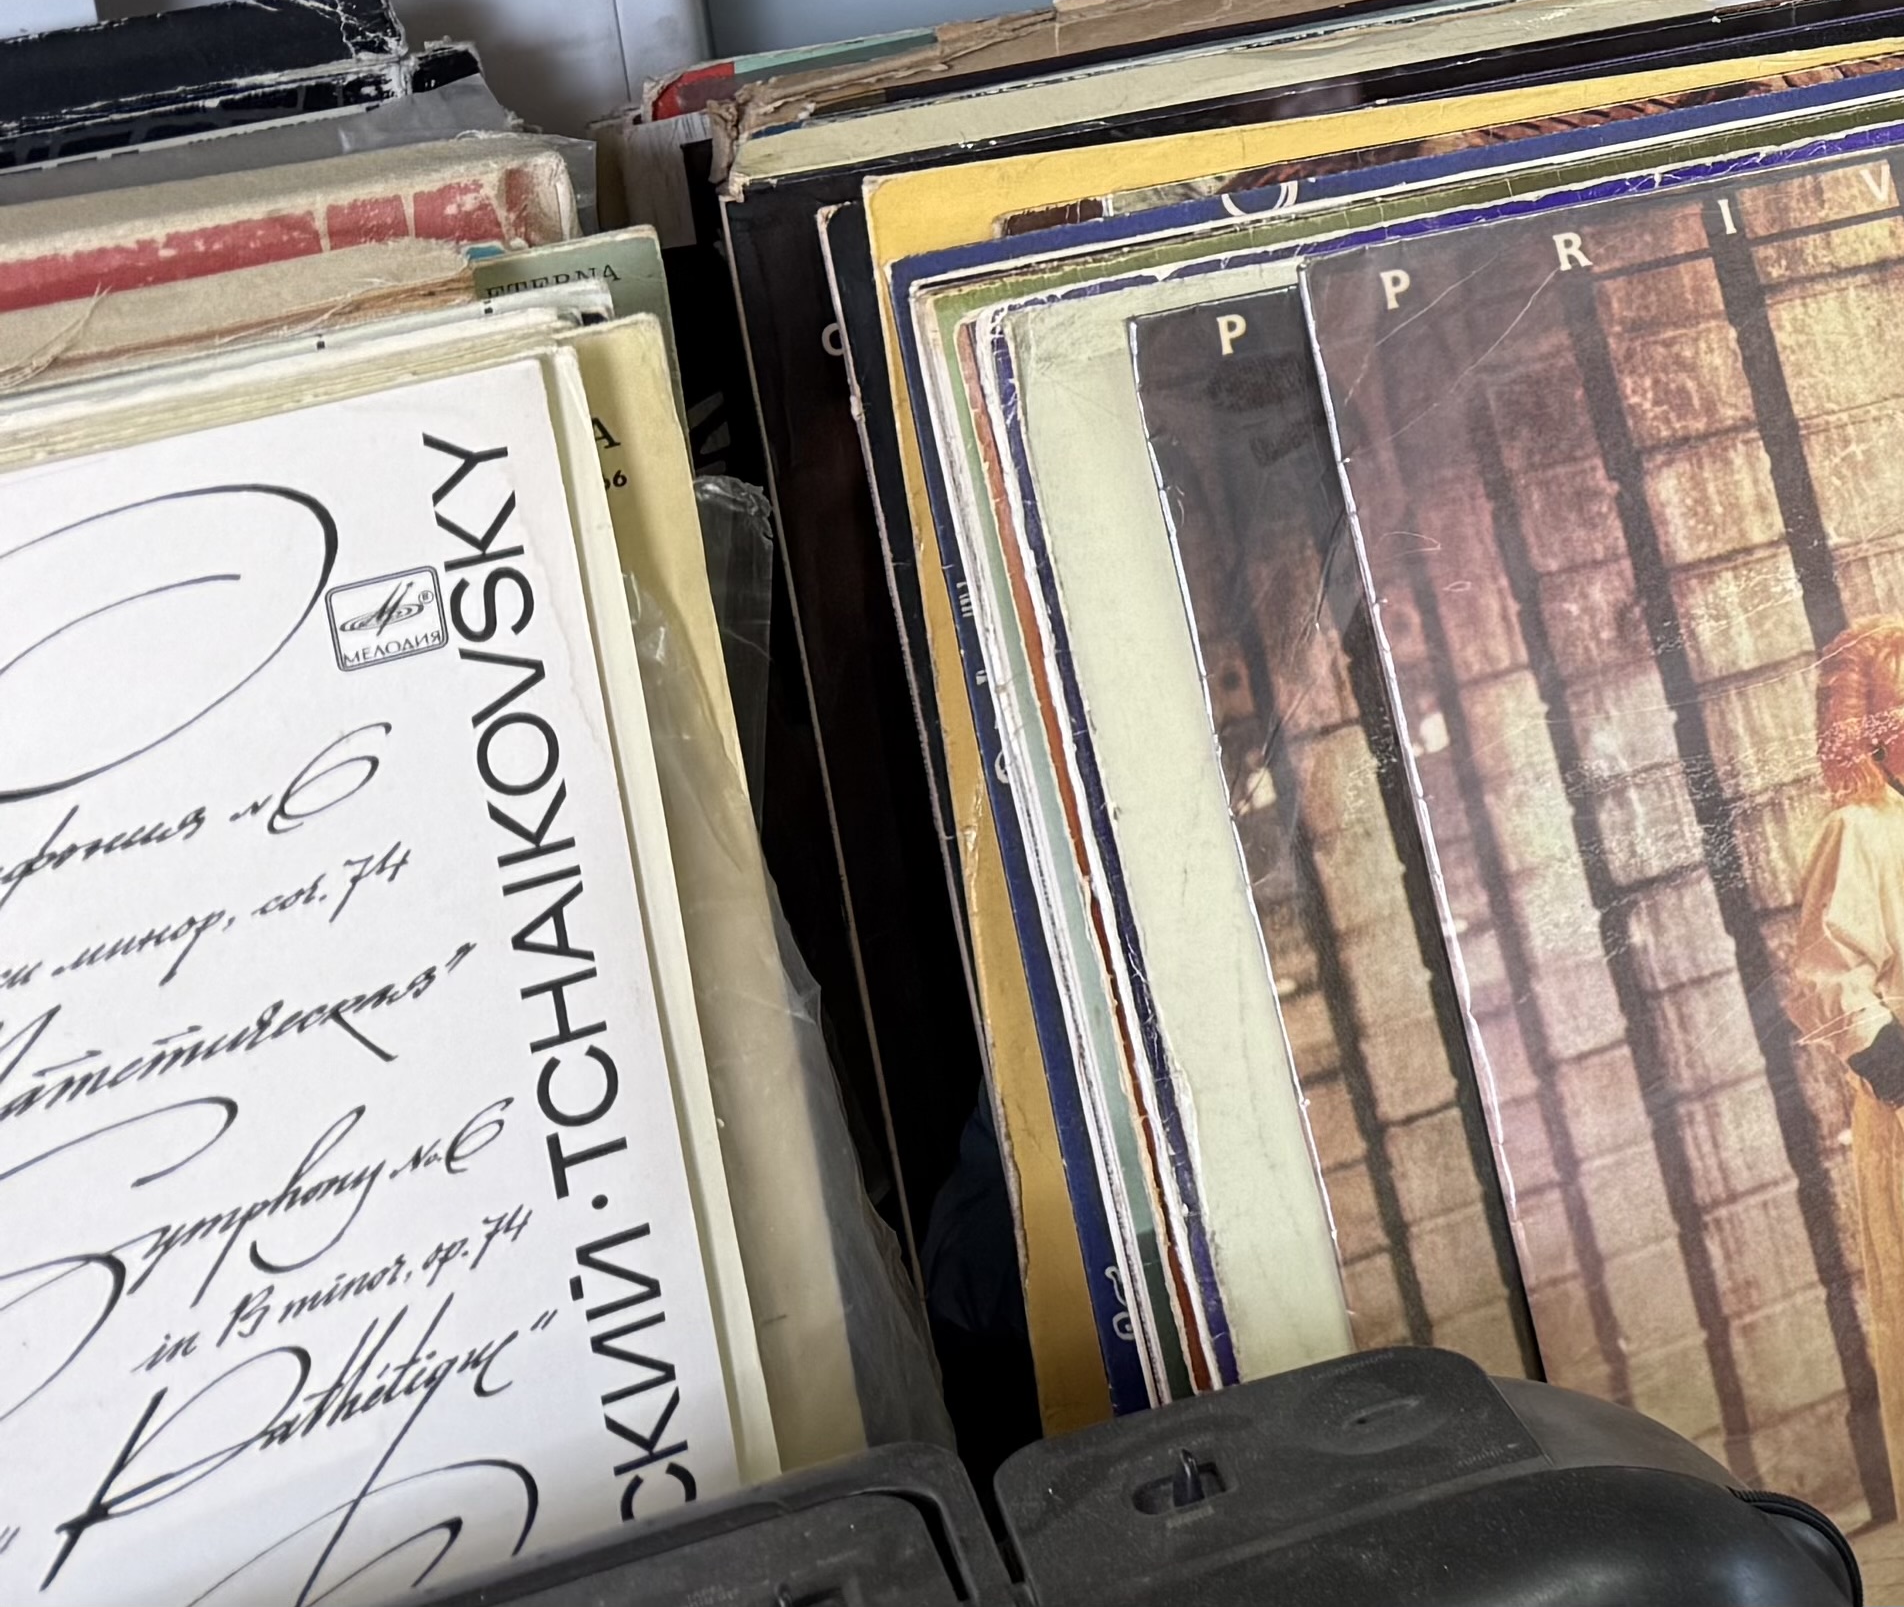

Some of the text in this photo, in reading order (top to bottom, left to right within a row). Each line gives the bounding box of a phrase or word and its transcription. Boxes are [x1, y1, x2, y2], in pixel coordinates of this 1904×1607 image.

[342, 628, 443, 665] МЕЛОДИЯ
[0, 722, 393, 903] фония 6
[423, 432, 627, 1199] TCHAIKOVSKY
[329, 841, 412, 923] 74
[445, 1096, 515, 1174] 6
[132, 1330, 200, 1375] in
[470, 1204, 534, 1270] 74
